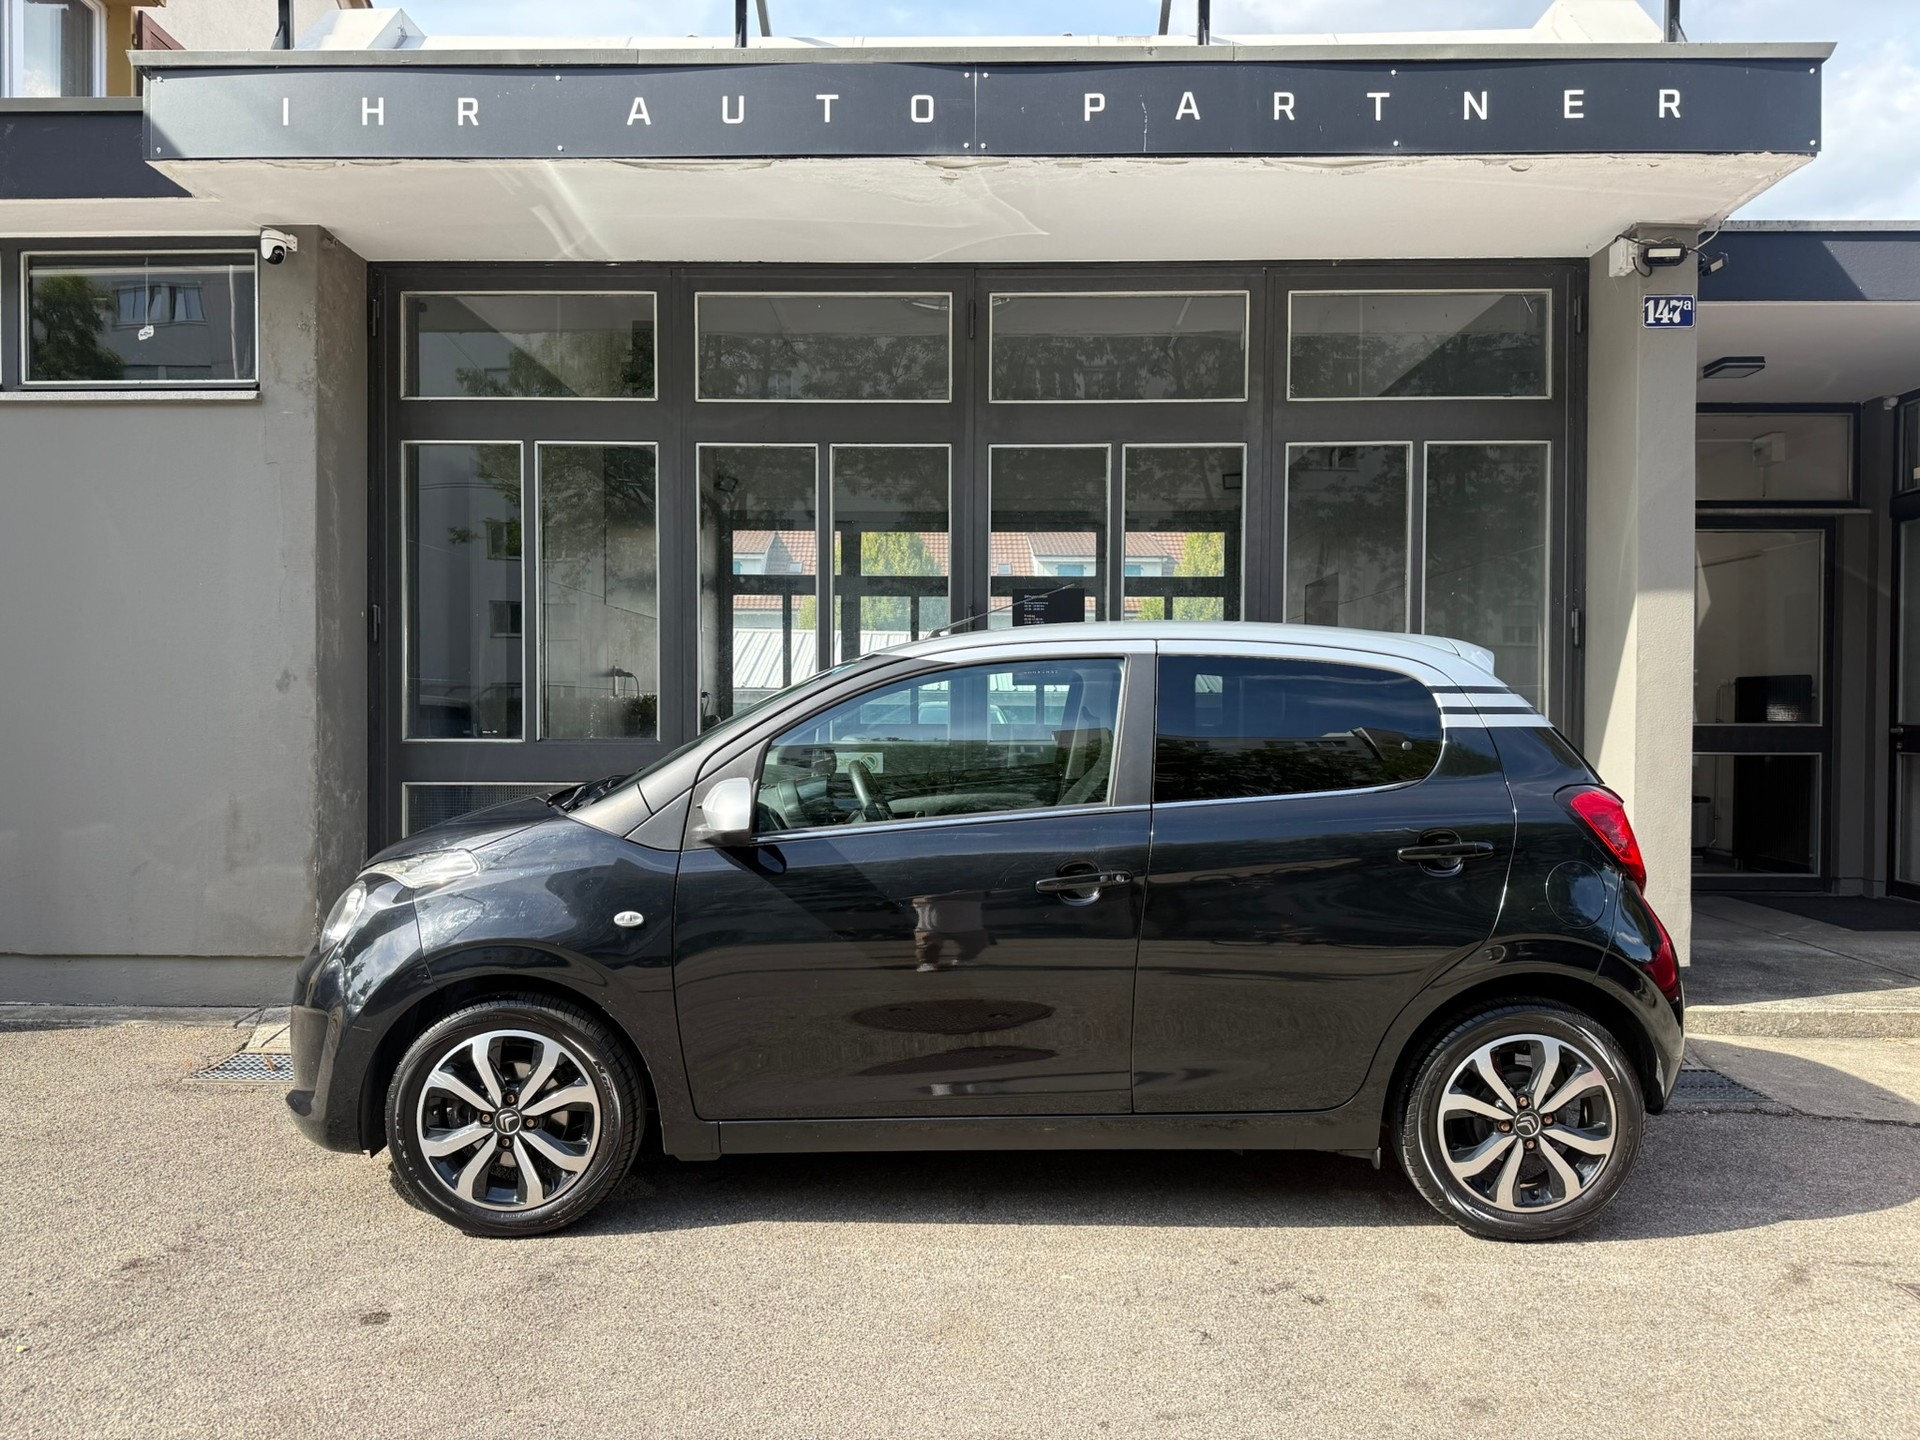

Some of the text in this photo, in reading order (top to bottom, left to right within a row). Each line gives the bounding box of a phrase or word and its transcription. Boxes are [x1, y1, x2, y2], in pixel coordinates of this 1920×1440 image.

[283, 89, 1682, 127] IHR AUTO PARTNER
[1645, 299, 1692, 324] 147a
